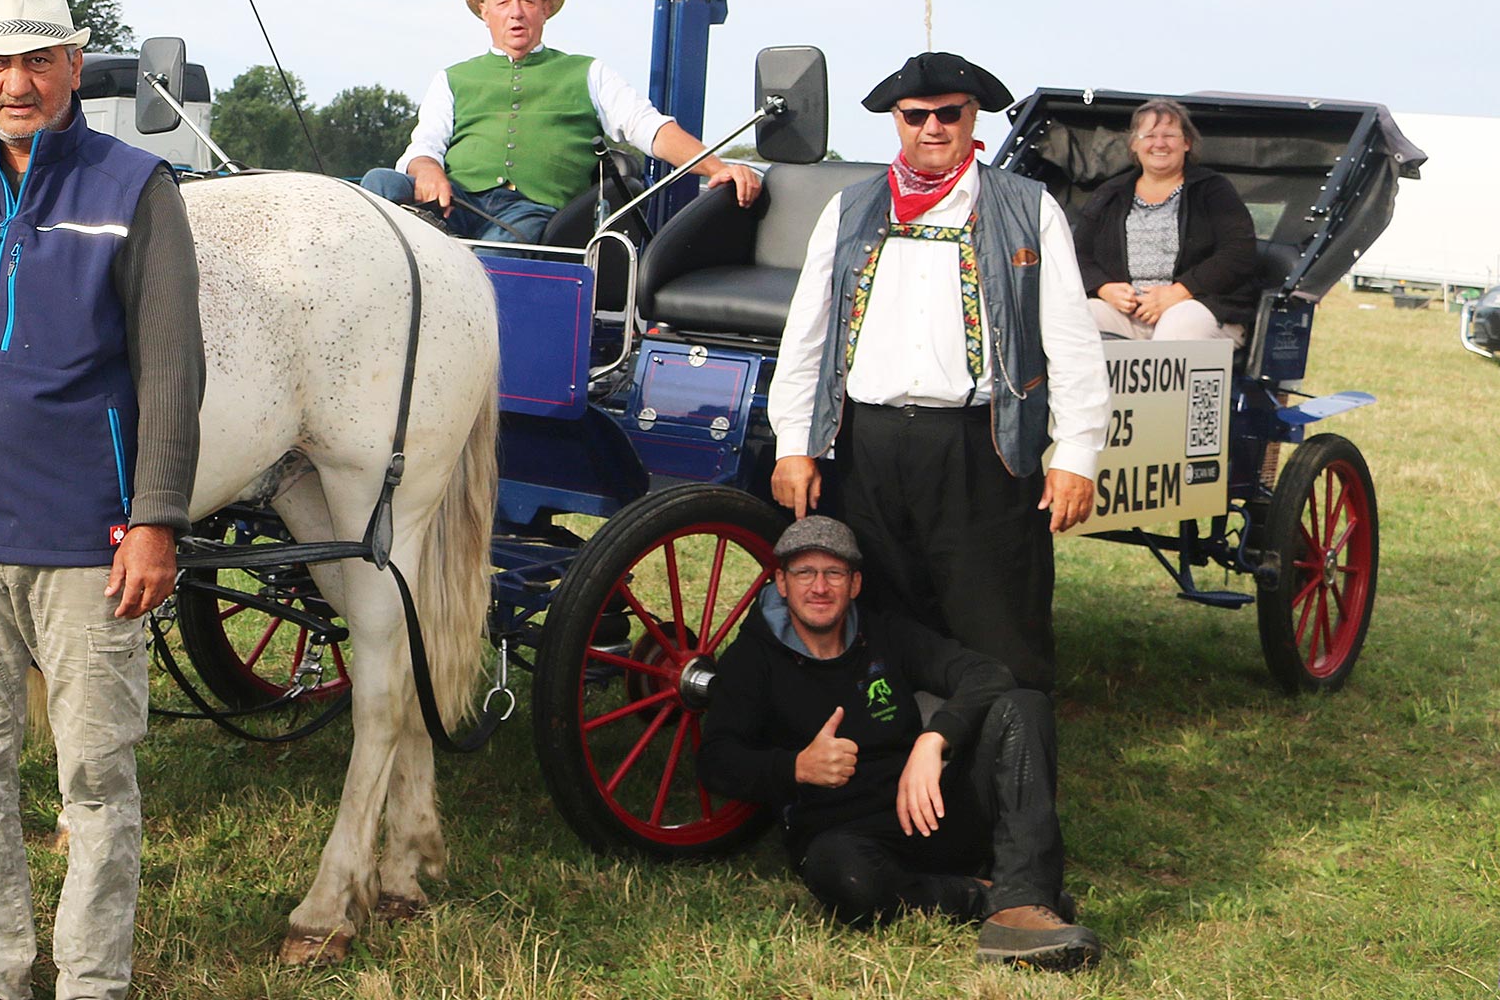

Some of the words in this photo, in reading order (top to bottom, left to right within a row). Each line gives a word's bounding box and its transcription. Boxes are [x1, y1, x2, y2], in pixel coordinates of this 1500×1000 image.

[1106, 358, 1185, 394] MISSION
[1104, 409, 1133, 447] 25
[1096, 463, 1180, 516] SALEM
